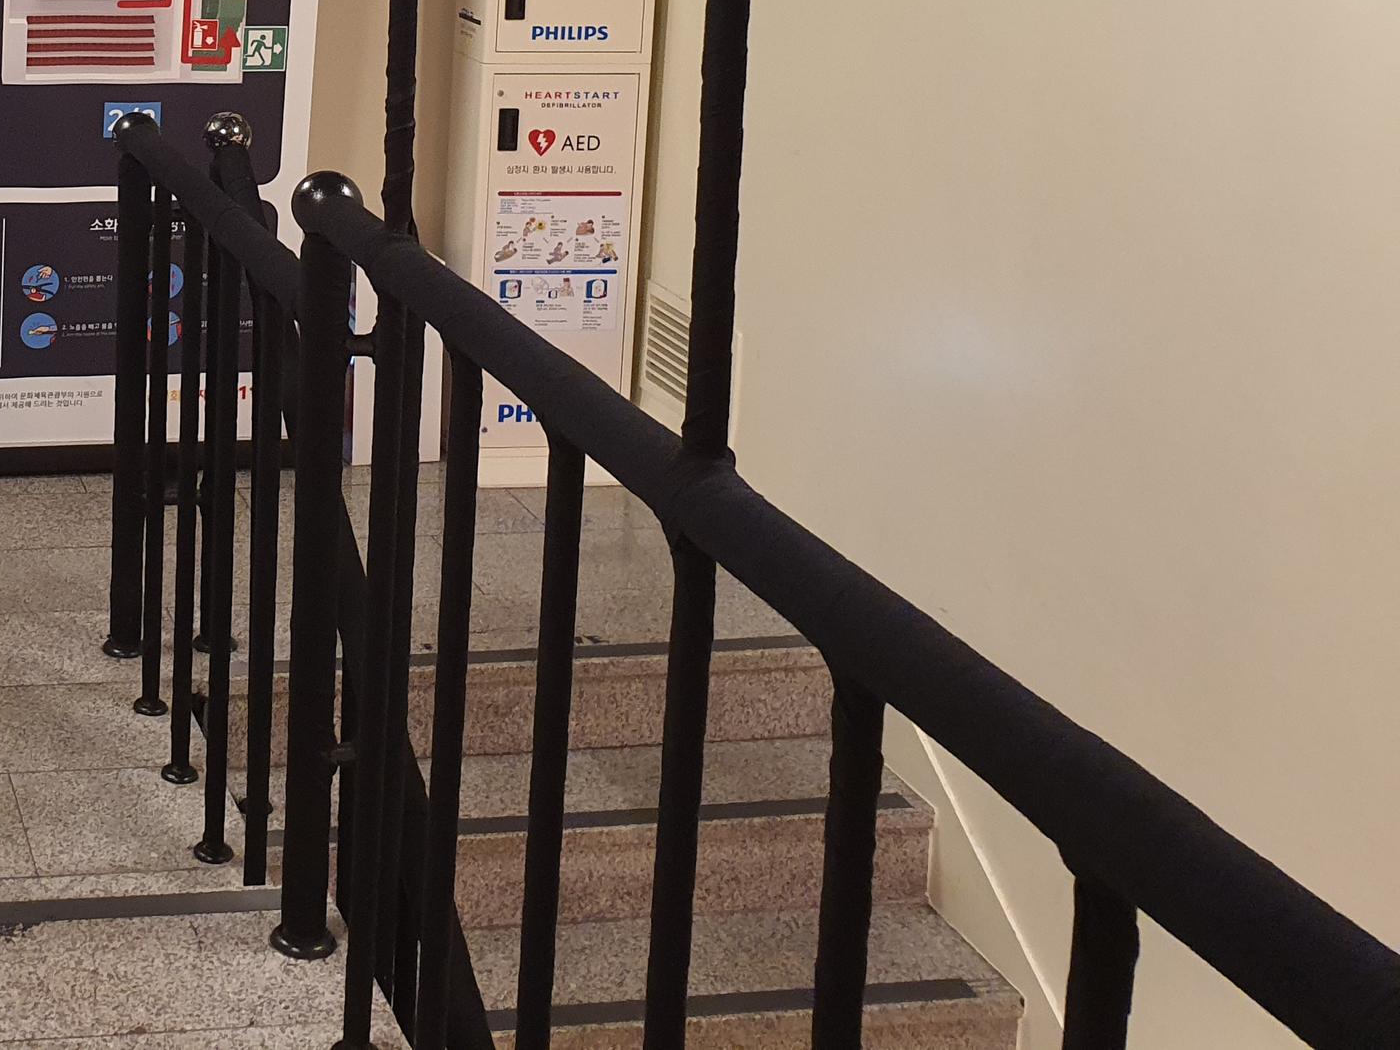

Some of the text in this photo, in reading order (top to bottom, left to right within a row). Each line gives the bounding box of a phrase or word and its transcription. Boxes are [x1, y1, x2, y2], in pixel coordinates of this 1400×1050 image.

[531, 26, 609, 41] PHILIPS
[524, 91, 620, 100] HEARTSTART
[561, 135, 601, 151] AED
[506, 165, 529, 175] 심정지
[532, 165, 548, 175] 환자
[551, 165, 573, 175] 발생시
